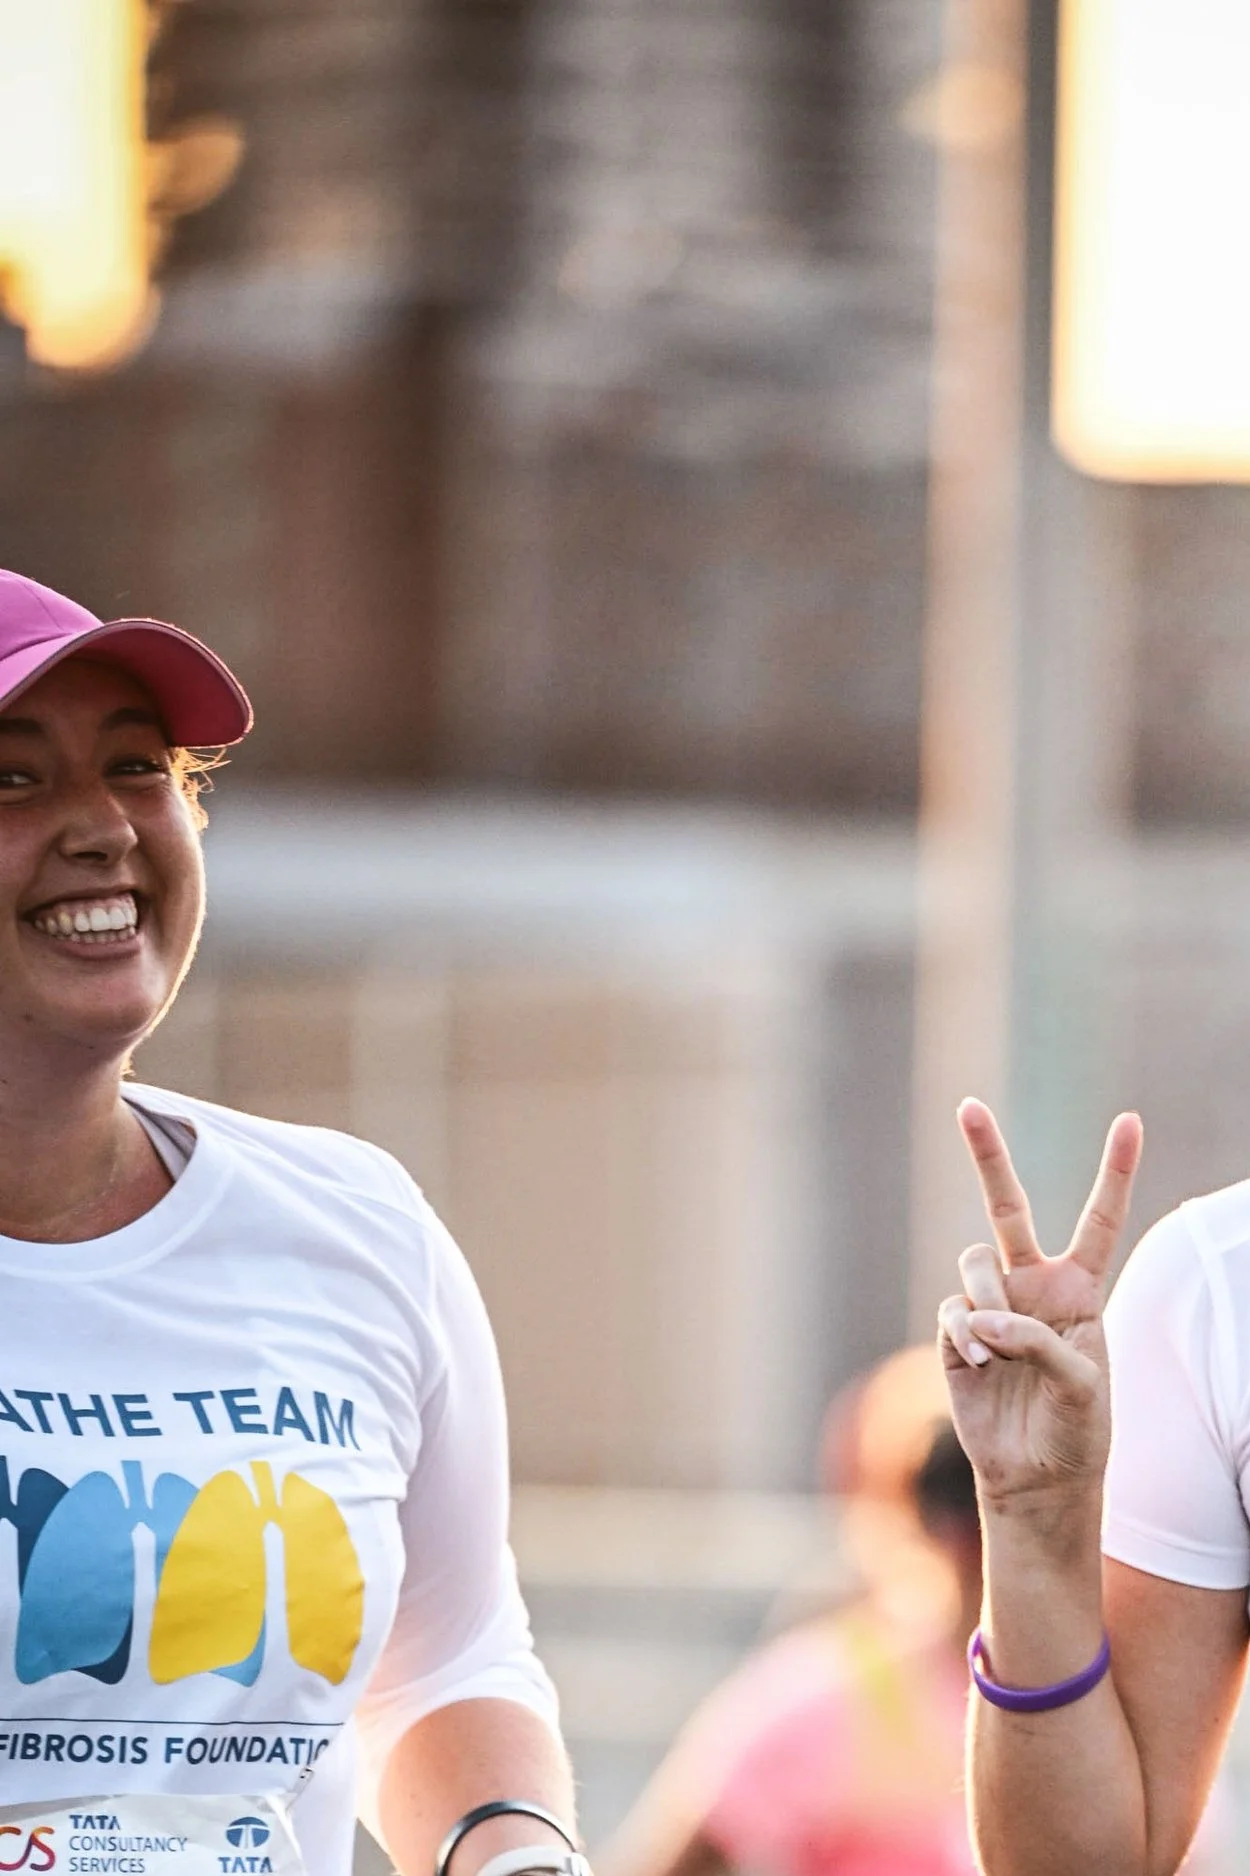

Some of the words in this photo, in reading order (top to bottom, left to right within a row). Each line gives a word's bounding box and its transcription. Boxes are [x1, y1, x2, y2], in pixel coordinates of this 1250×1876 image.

[172, 1386, 362, 1451] TEAM
[69, 1815, 121, 1830] TATA
[69, 1835, 189, 1853] CONSULTANCY
[69, 1857, 146, 1874] SERVICES
[218, 1856, 273, 1874] TATA
